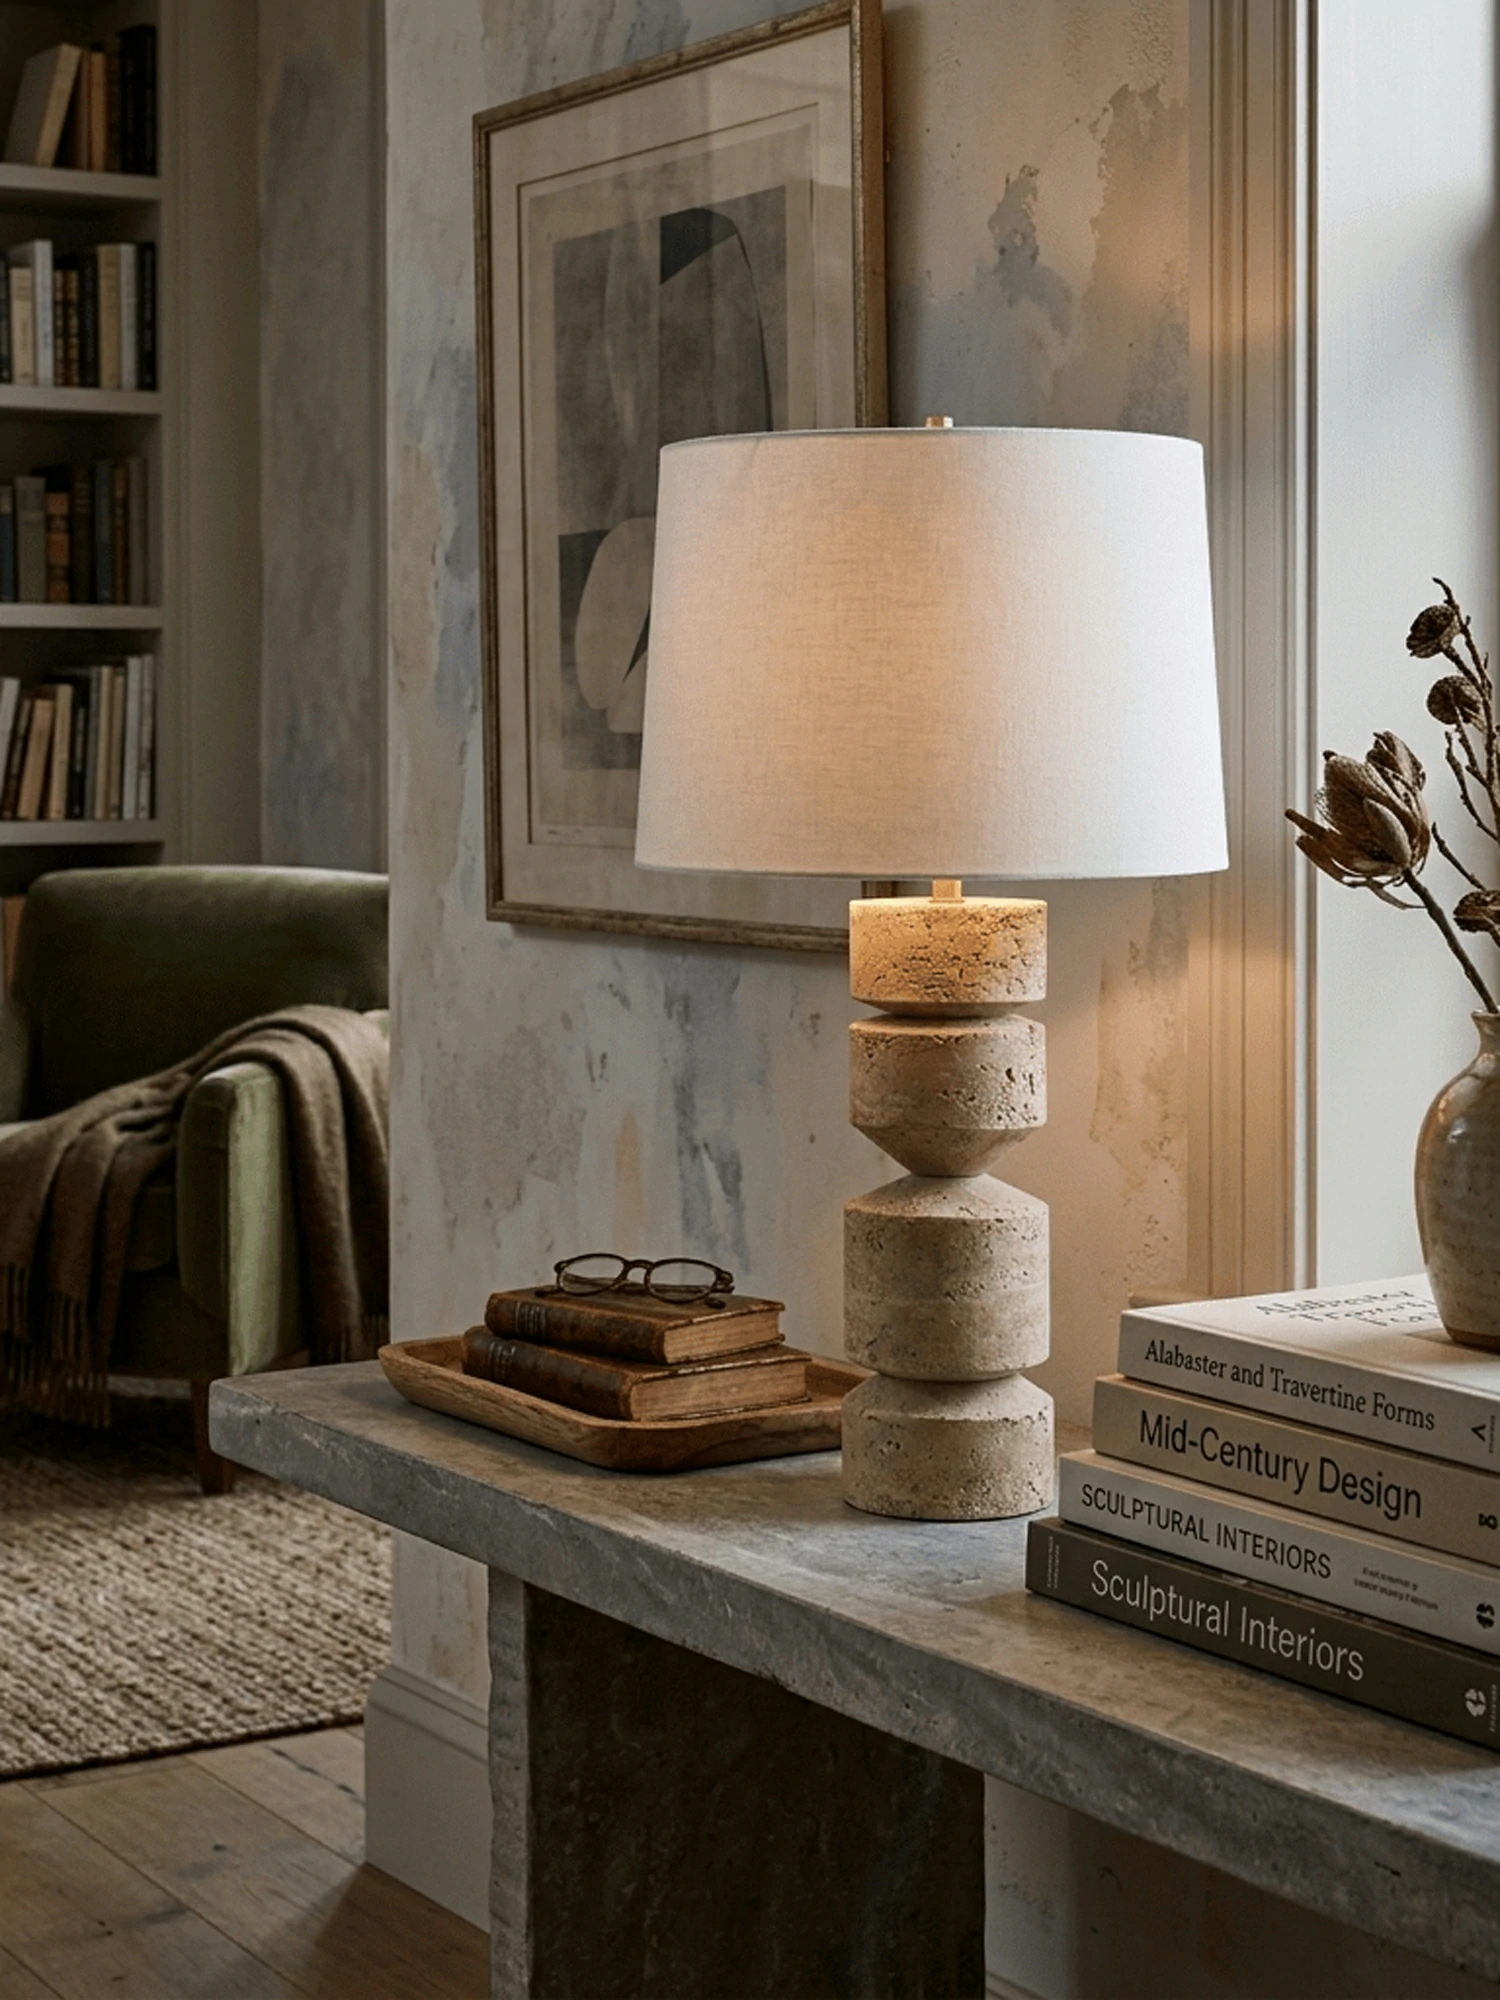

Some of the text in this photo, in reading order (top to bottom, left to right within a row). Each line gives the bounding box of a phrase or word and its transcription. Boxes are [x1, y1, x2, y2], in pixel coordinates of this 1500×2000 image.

[1145, 1339, 1435, 1431] Alabaster and Travertine Forms
[1140, 1410, 1421, 1522] Mid-Century Design
[1081, 1484, 1210, 1543] SCULPTURAL
[1216, 1522, 1331, 1580] INTERIORS
[1091, 1559, 1230, 1637] Sculptural
[1240, 1606, 1364, 1681] Interiors
